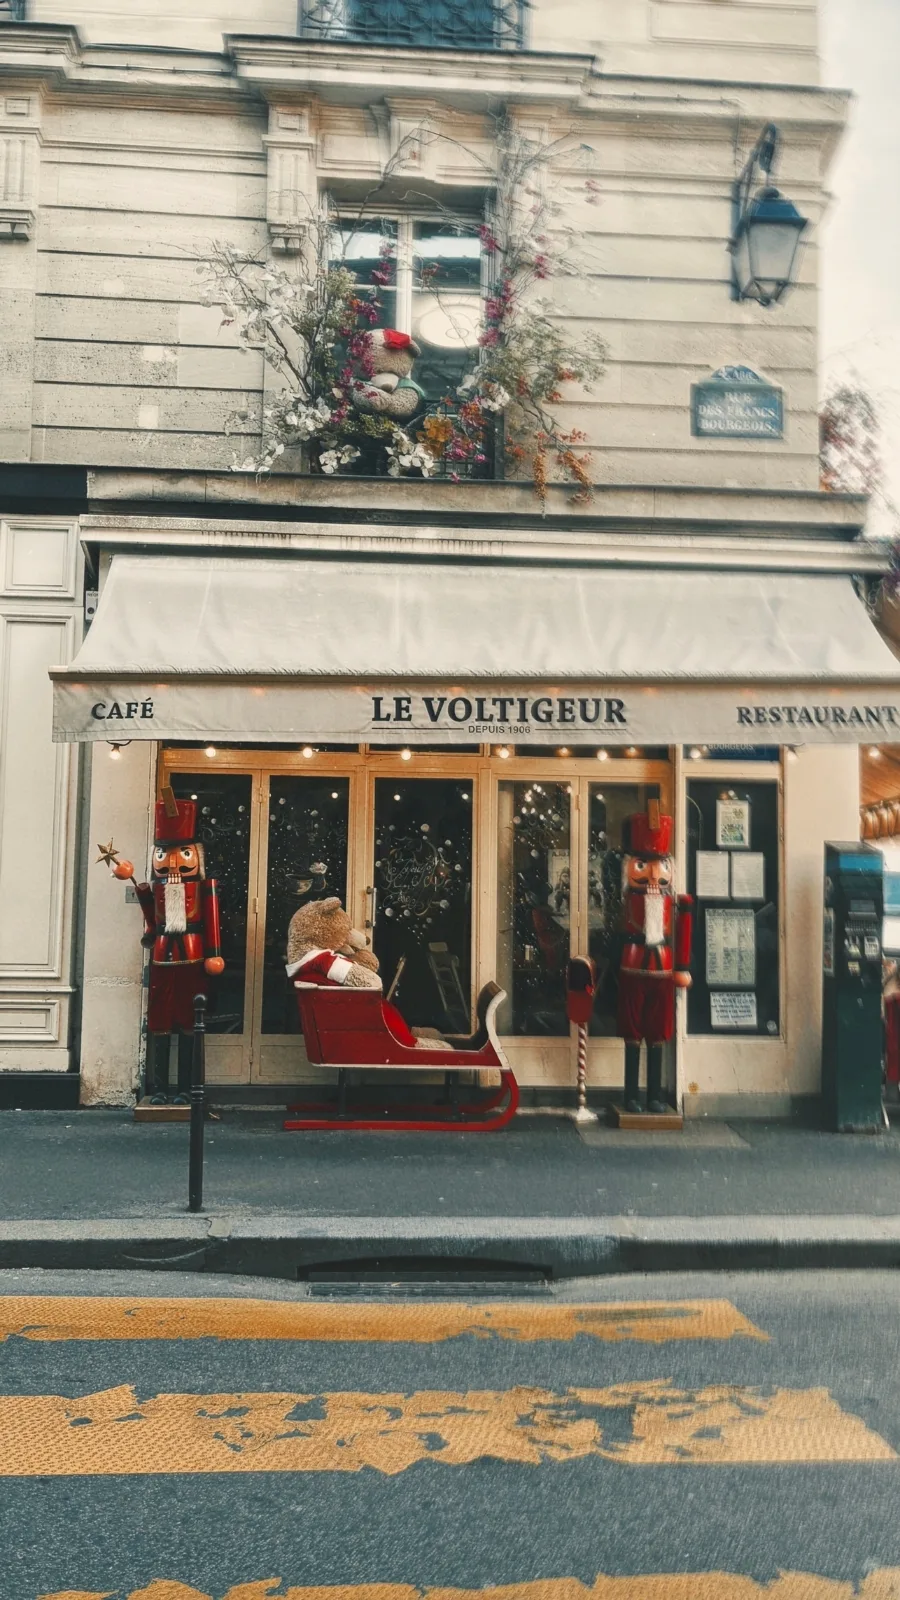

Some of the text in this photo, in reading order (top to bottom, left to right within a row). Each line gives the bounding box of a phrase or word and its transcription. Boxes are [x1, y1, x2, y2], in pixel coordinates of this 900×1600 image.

[725, 391, 752, 403] RUE
[698, 404, 776, 418] DES FRANCS
[700, 419, 774, 431] BOURGEOIS
[90, 697, 154, 719] CAFÉ
[371, 696, 627, 723] LE VOLTIGEUR
[736, 706, 898, 724] RESTAURANT
[468, 725, 531, 734] DEPUIS 1906
